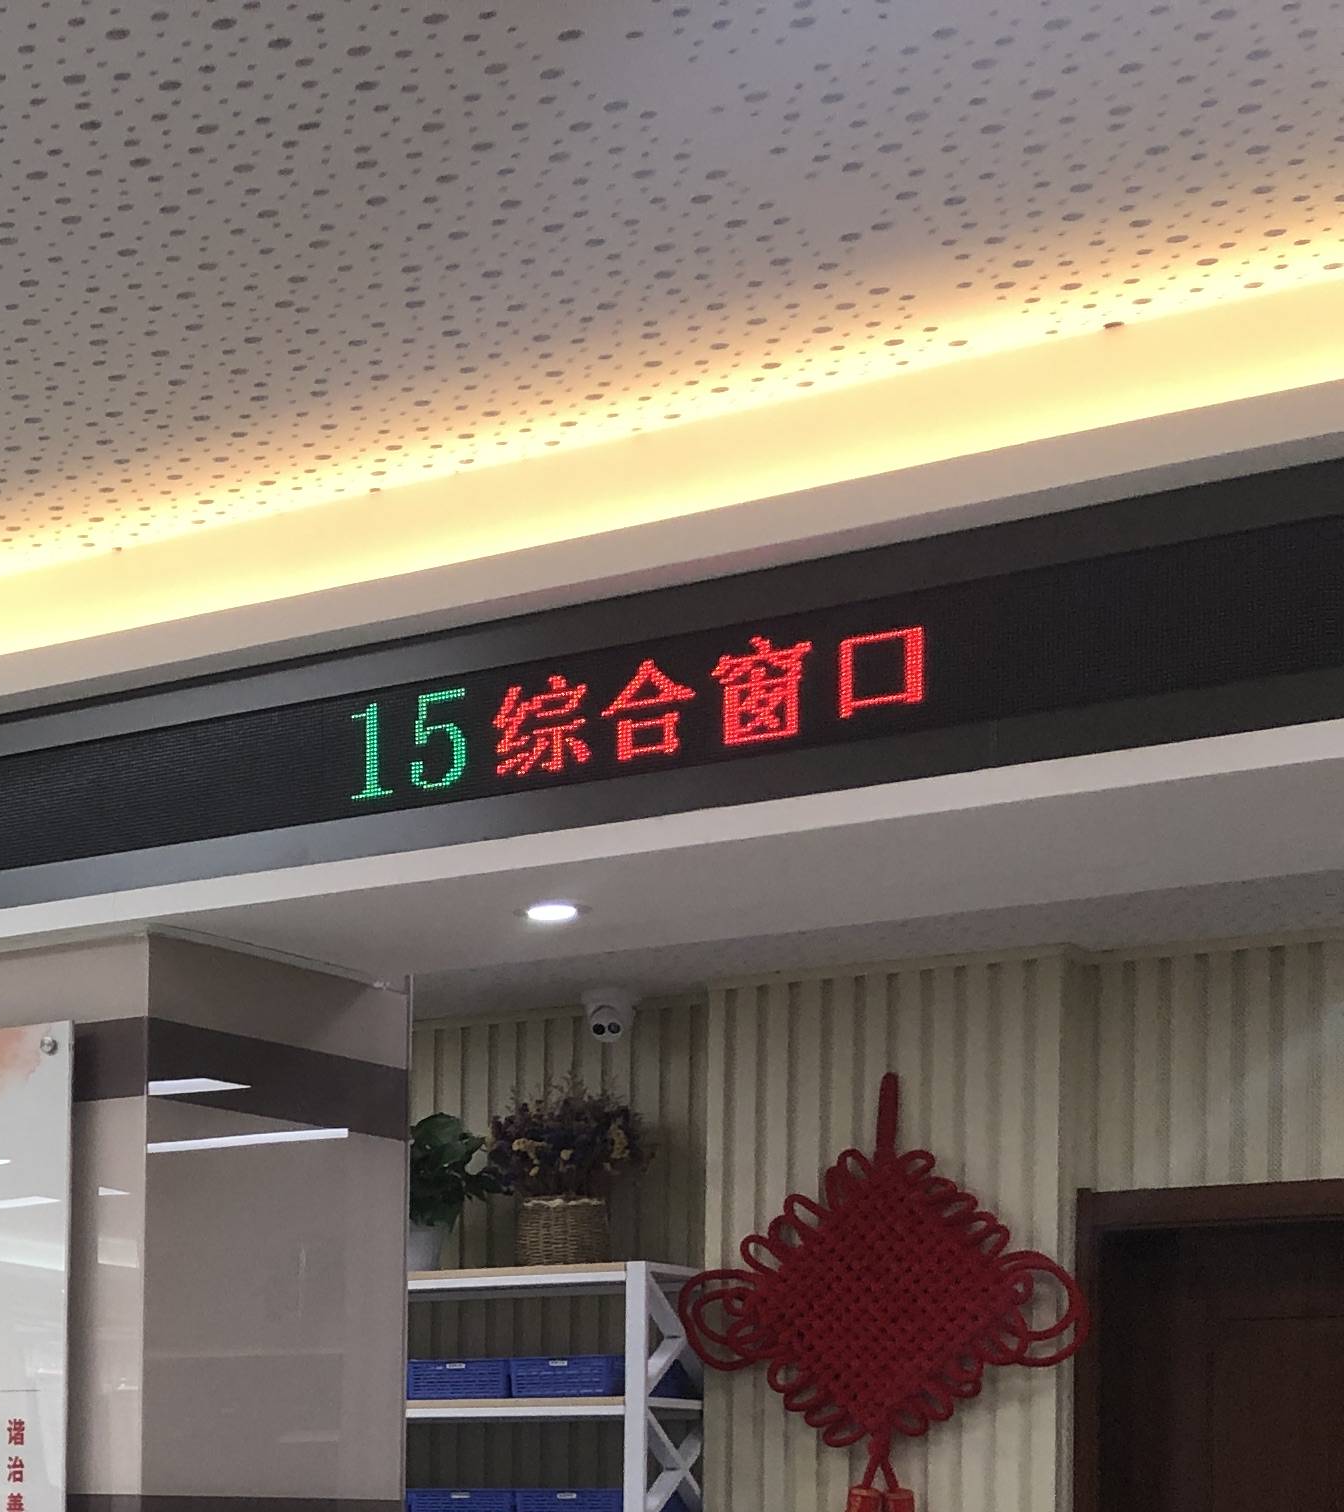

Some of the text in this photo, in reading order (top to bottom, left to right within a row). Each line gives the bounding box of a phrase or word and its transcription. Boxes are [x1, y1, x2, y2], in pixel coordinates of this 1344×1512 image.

[353, 628, 925, 802] 15 综合窗口
